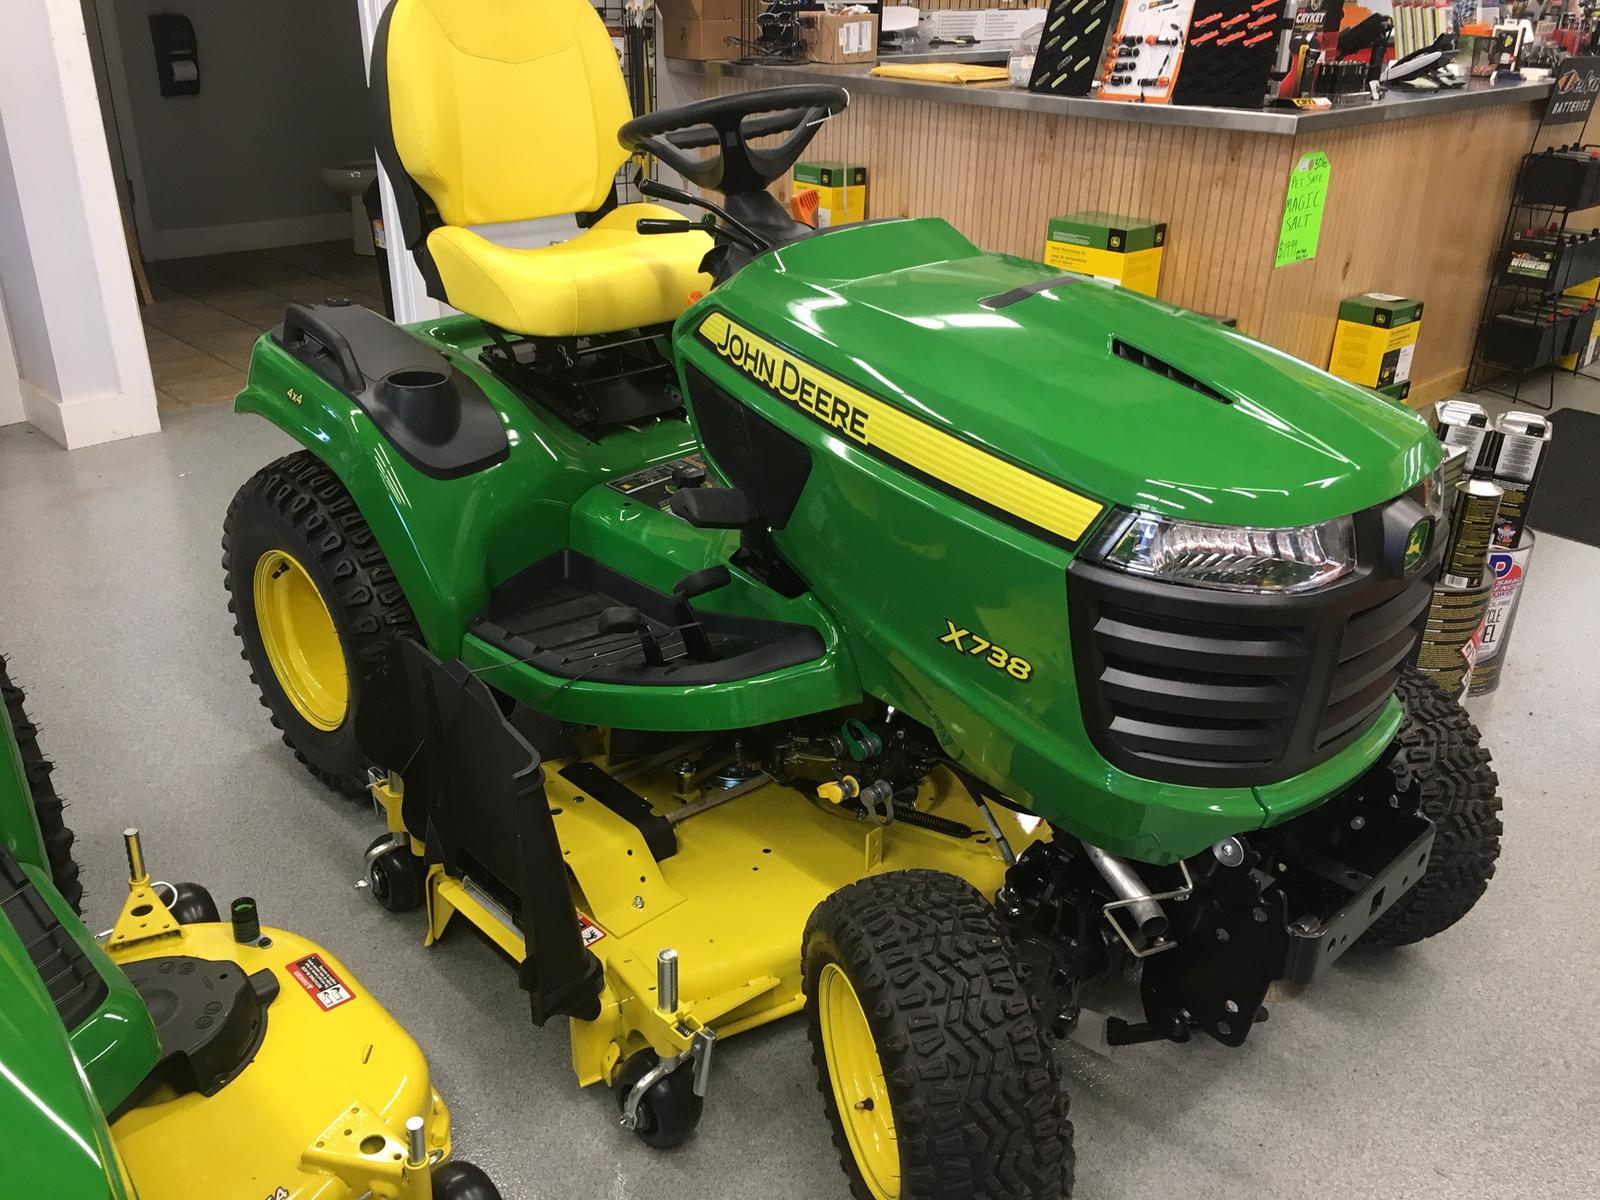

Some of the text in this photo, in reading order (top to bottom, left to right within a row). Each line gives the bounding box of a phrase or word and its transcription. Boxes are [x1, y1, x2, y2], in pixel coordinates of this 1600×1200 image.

[1295, 12, 1327, 24] CRYKET
[1551, 99, 1591, 115] BATTERIES
[1286, 191, 1321, 213] MAGIC
[1285, 213, 1312, 232] SALT
[716, 323, 869, 440] JOHN DEERE
[938, 618, 1033, 682] X738
